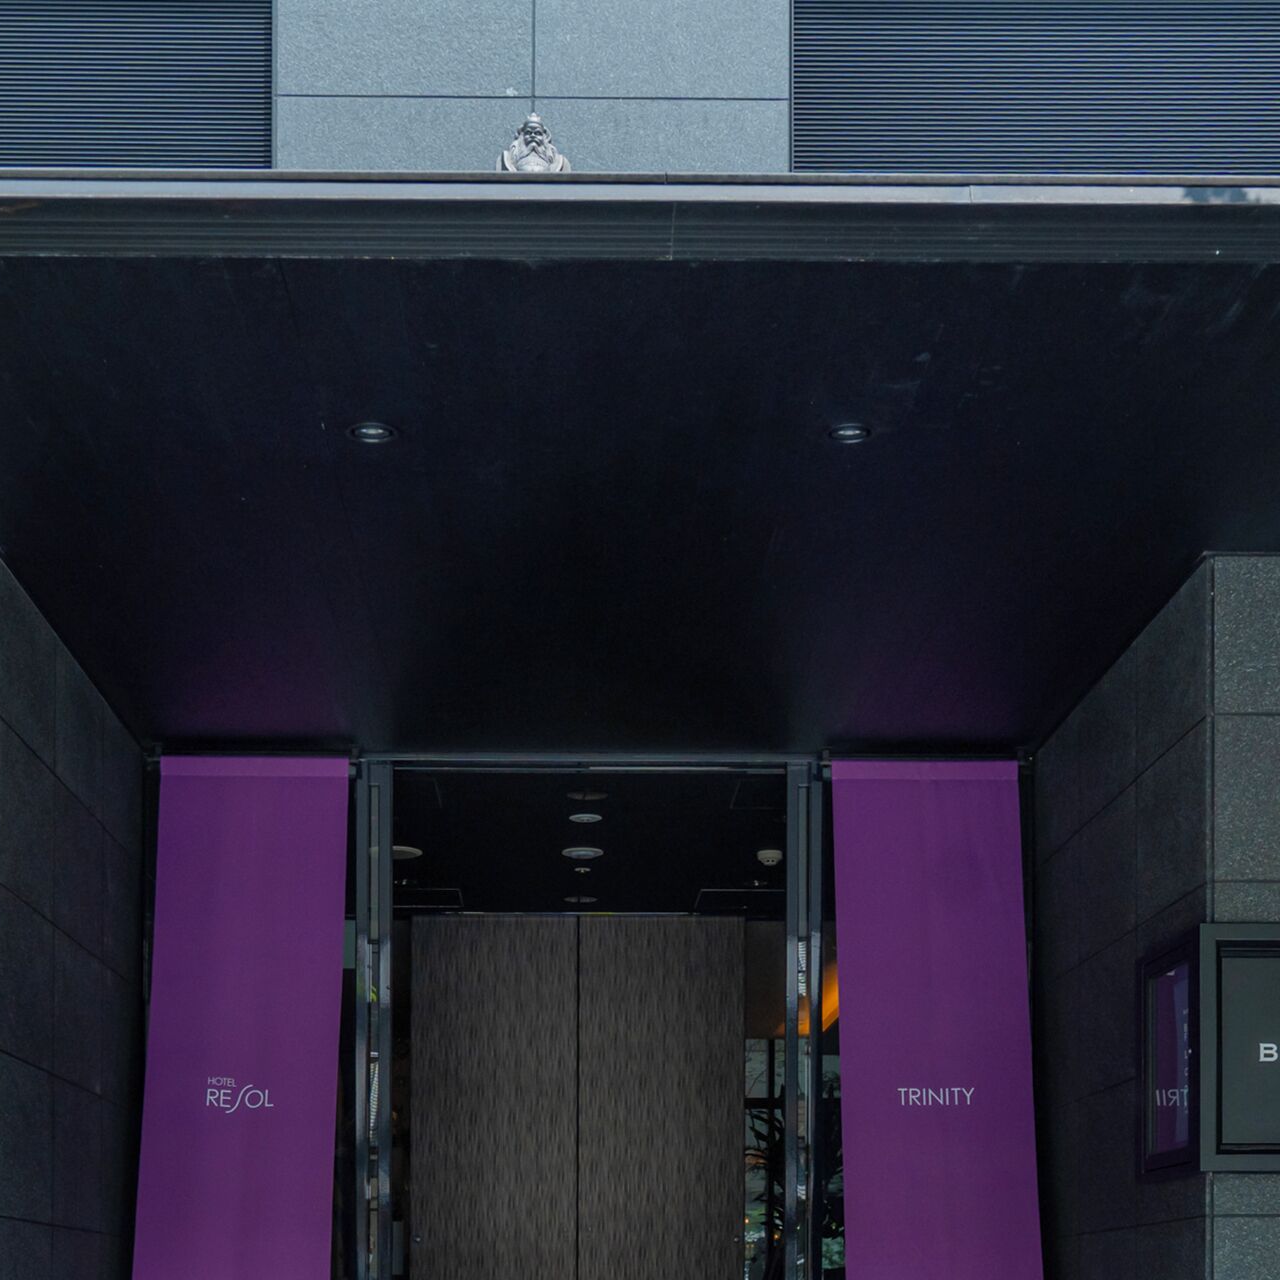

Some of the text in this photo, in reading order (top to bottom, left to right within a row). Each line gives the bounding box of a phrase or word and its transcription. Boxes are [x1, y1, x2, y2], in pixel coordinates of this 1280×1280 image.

[207, 1076, 237, 1088] HOTEL
[206, 1084, 274, 1114] RESOL
[897, 1087, 975, 1106] TRINITY
